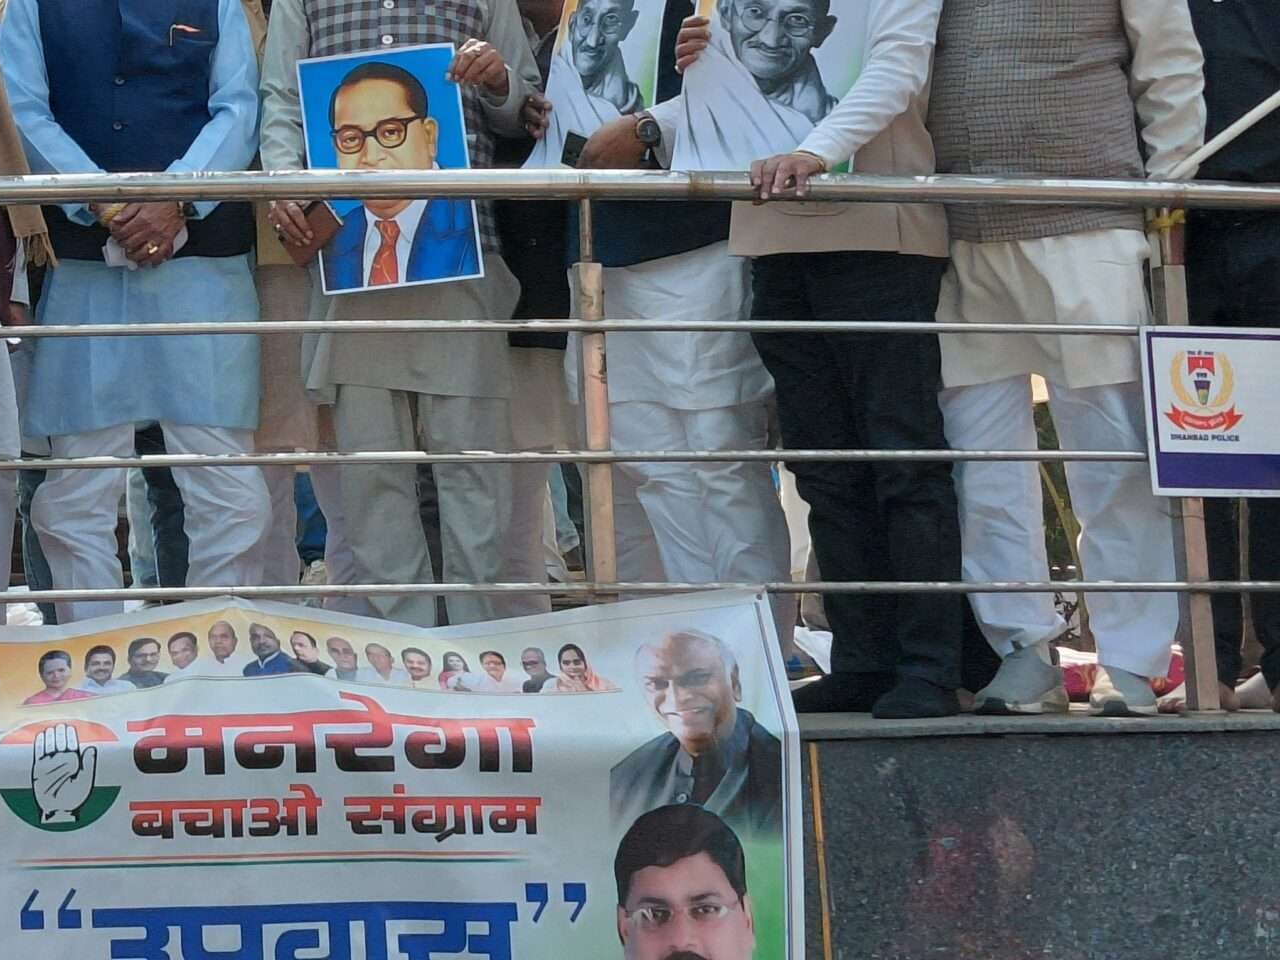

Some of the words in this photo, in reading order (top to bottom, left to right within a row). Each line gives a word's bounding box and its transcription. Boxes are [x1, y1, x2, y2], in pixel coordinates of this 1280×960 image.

[1211, 434, 1240, 442] POLICE
[127, 691, 536, 775] मनरेगा
[129, 783, 323, 840] बचाओ
[344, 783, 542, 843] संग्राम
